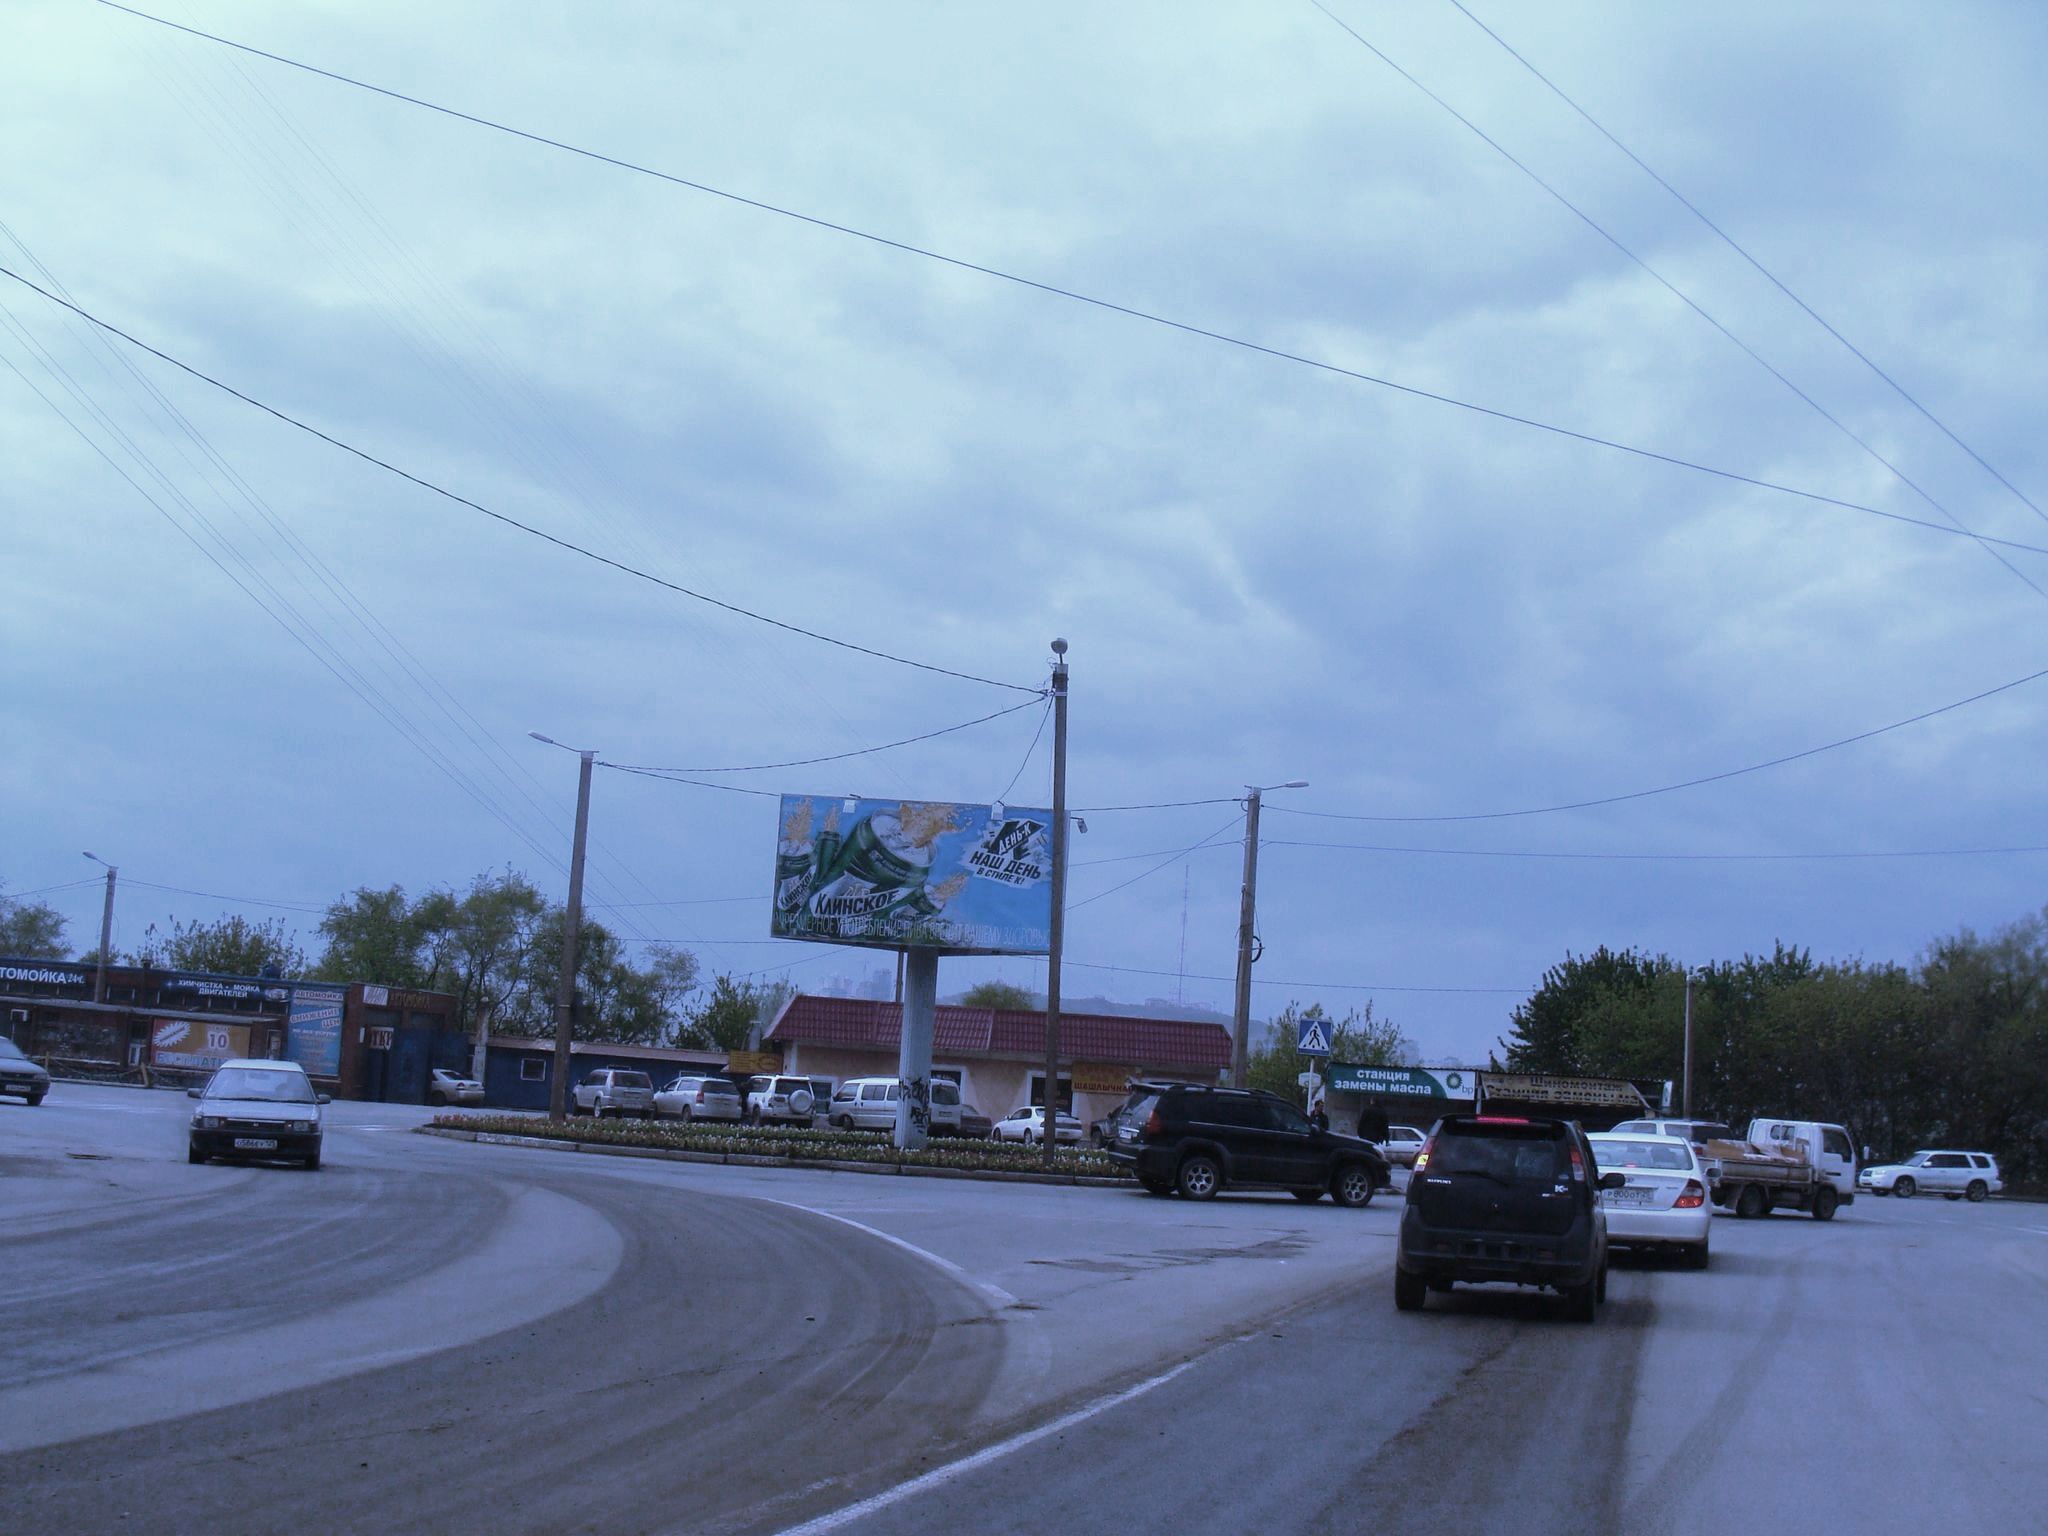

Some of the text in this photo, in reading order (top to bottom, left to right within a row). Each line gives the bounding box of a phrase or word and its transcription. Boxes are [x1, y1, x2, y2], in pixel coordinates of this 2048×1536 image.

[999, 823, 1031, 854] ДЕНЬ-К
[969, 851, 1042, 879] НАШ ДЕНЬ
[976, 867, 985, 875] В
[985, 869, 1014, 883] СТИЛЕ
[178, 980, 260, 993] ХИМЧИСТКА МОЙКА
[198, 987, 248, 998] ДВИГАТЕЛЕЙ
[295, 990, 344, 1001] АВТОМОЙКА
[209, 1033, 228, 1048] 10
[1356, 1069, 1410, 1081] станция
[1334, 1079, 1432, 1095] замены масла
[1461, 1085, 1474, 1095] bp
